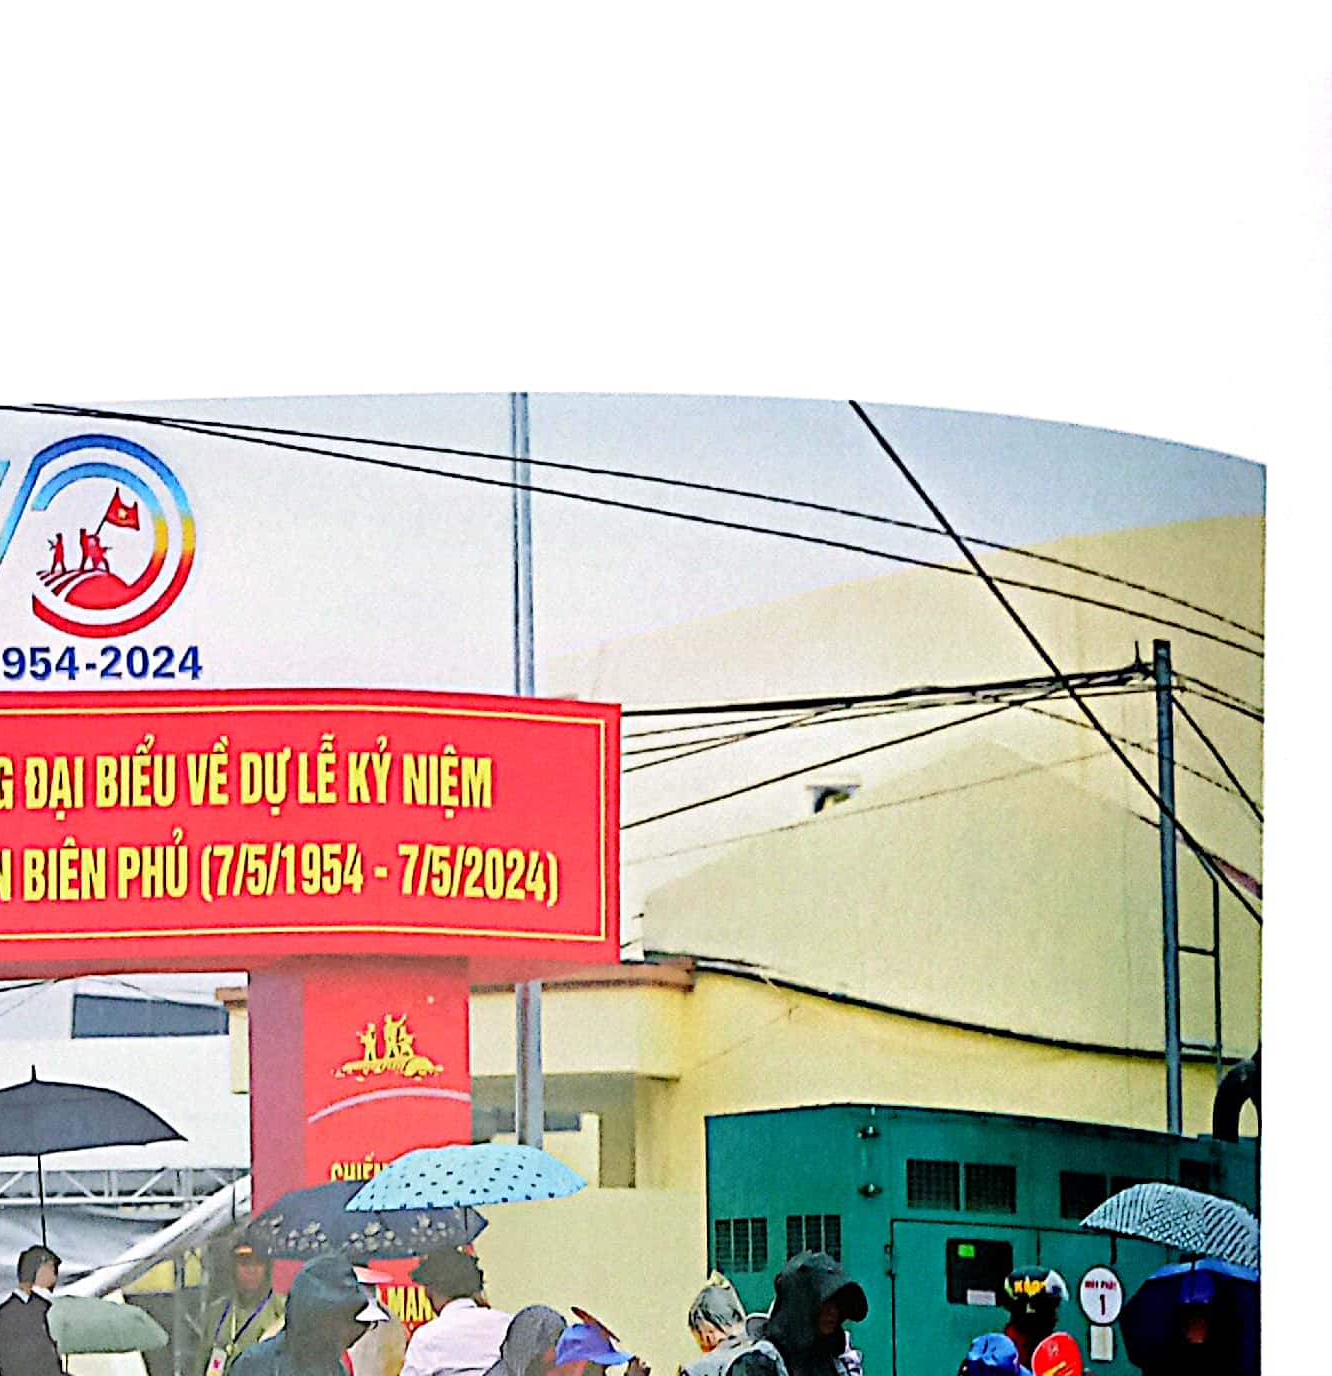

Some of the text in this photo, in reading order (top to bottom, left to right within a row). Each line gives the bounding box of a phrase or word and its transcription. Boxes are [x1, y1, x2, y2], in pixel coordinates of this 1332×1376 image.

[24, 756, 84, 821] ĐẠI
[96, 734, 176, 808] BIỂU
[186, 735, 229, 806] VỀ
[240, 747, 292, 816] DỰ
[298, 732, 337, 804] LỄ
[348, 735, 392, 804] KỶ
[403, 744, 492, 819] NIỆM
[23, 836, 106, 901] BIÊN
[118, 827, 188, 899] PHỦ
[201, 842, 364, 903] (7/5/1954
[398, 844, 558, 908] 7/5/2024)
